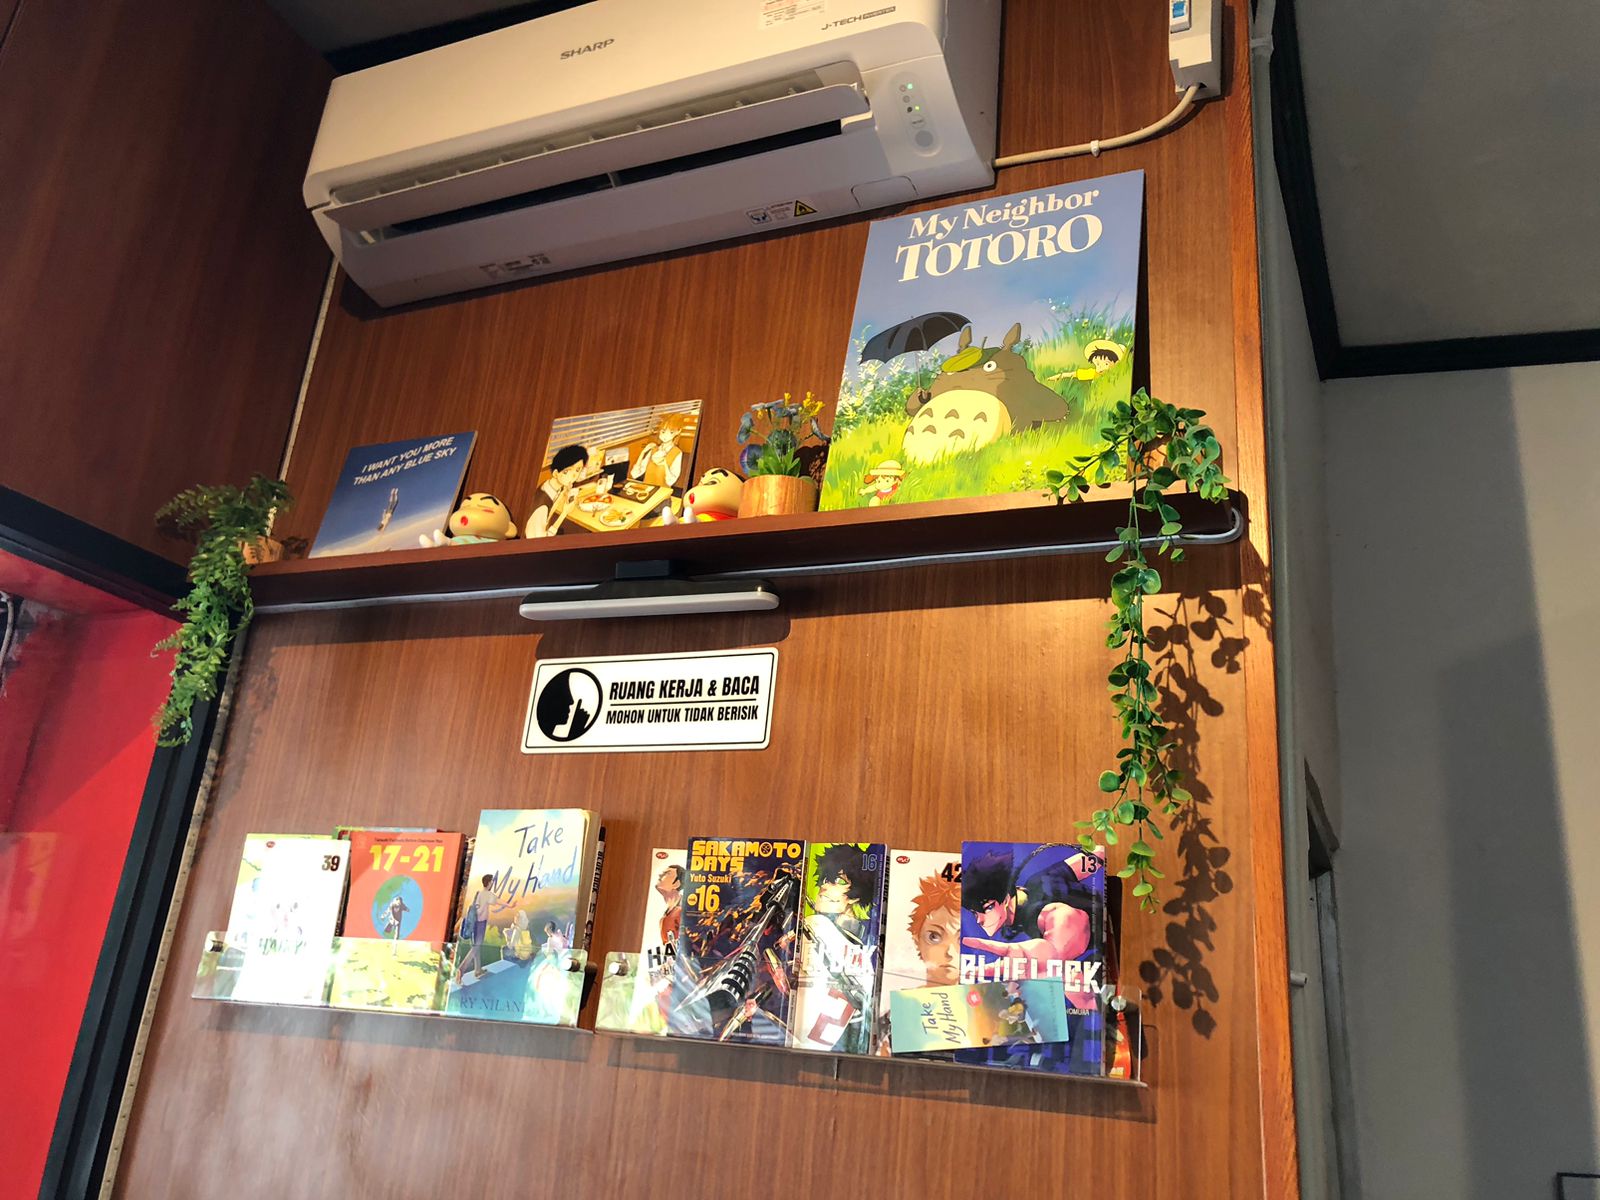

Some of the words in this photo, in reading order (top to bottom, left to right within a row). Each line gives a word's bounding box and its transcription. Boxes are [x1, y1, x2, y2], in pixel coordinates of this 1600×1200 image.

[560, 38, 615, 60] SHARP
[908, 213, 959, 240] My
[962, 190, 1099, 229] Neighbor
[895, 214, 1103, 282] TOTORO
[353, 472, 381, 485] THAN
[380, 463, 404, 478] ANY
[404, 452, 434, 470] BLUE
[434, 446, 457, 460] SKY
[368, 455, 398, 472] WANT
[399, 446, 423, 461] YOU
[422, 436, 456, 453] MORE
[609, 680, 656, 701] RUANG
[658, 678, 703, 699] KERJA
[707, 679, 718, 697] &
[722, 675, 760, 696] BACA
[605, 709, 646, 725] MOHON
[647, 708, 682, 723] UNTUK
[684, 706, 715, 722] TIDAK
[717, 704, 759, 721] BERISIK
[514, 821, 564, 858] Take
[692, 840, 802, 859] SAKAMOTO
[321, 855, 341, 872] 39
[369, 844, 445, 873] 17-21
[690, 855, 745, 873] DAYS
[862, 853, 878, 871] 16
[1081, 855, 1098, 873] 13
[690, 873, 706, 883] Yuto
[707, 873, 732, 884] Suzuki
[941, 862, 962, 883] 42
[488, 865, 521, 913] My
[695, 884, 721, 912] 16
[920, 1002, 939, 1035] Take
[930, 992, 957, 1022] Hand
[942, 1024, 967, 1044] My
